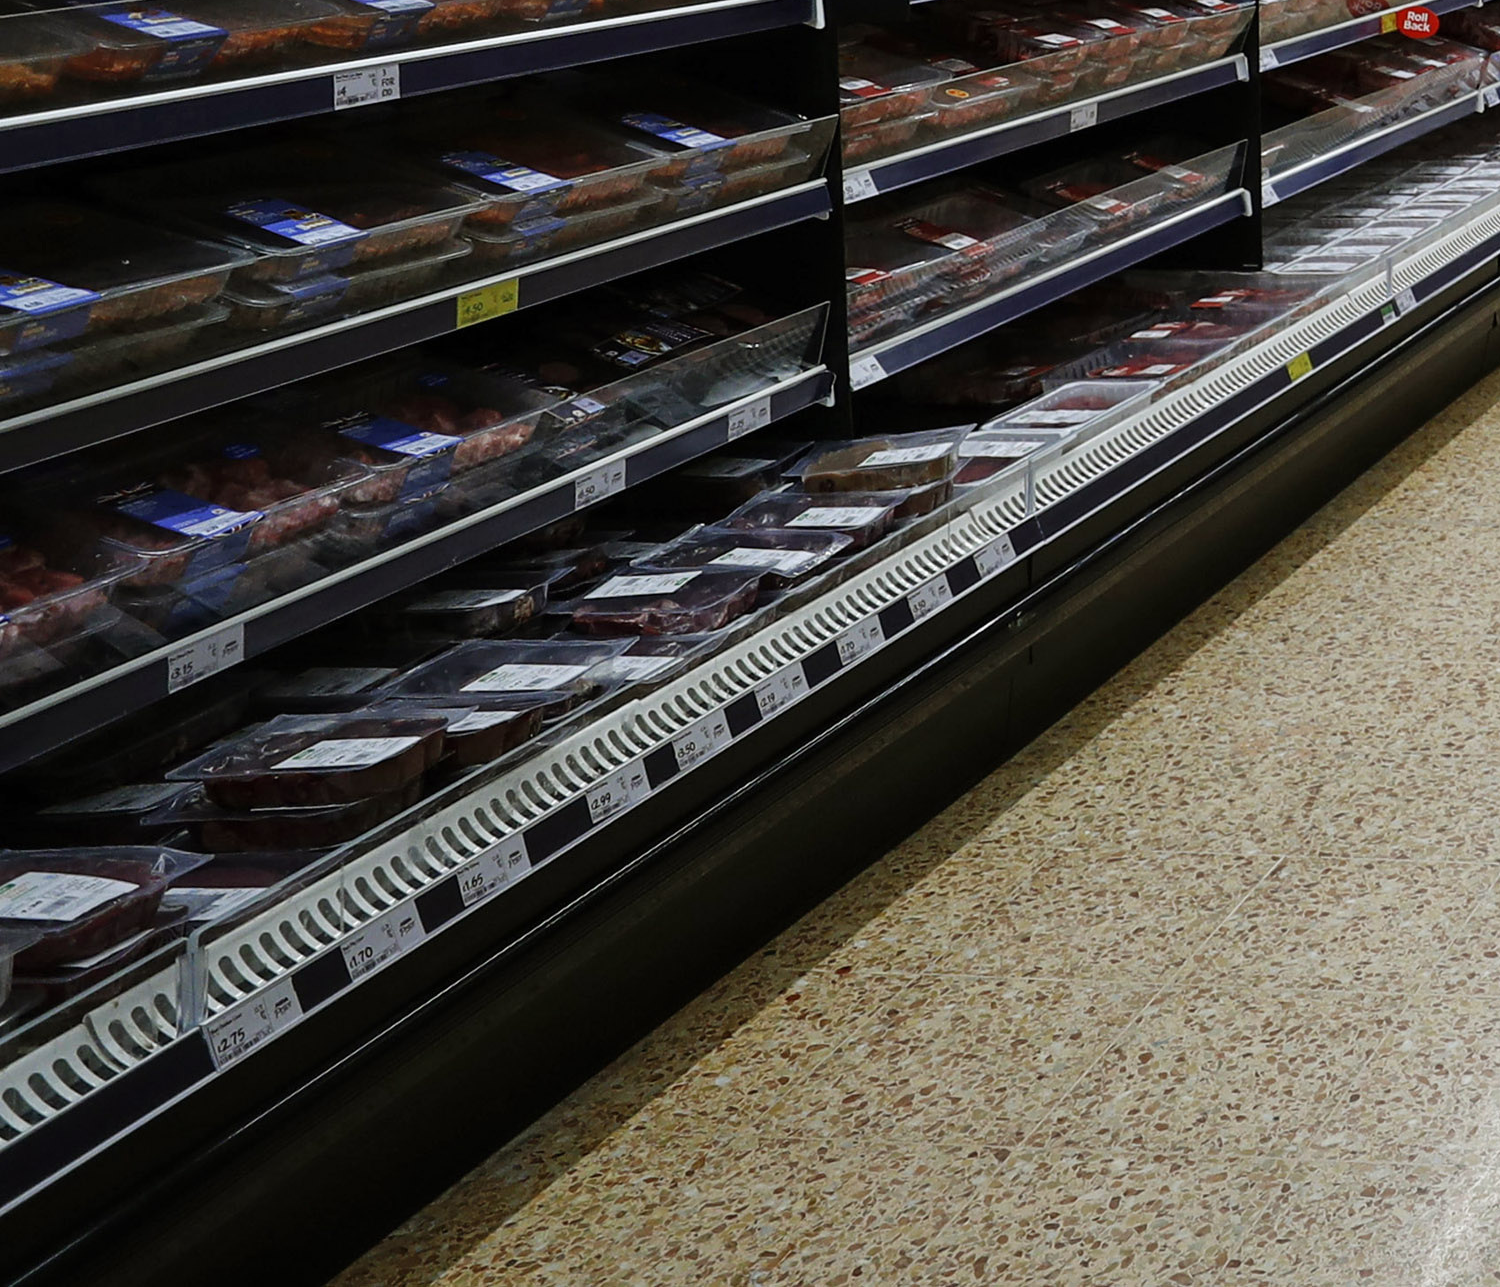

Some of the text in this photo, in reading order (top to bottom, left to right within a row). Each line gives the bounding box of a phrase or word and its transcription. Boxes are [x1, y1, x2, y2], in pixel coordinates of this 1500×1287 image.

[1407, 11, 1429, 22] Roll
[1403, 20, 1431, 33] Back
[349, 947, 373, 969] £1.70
[218, 1028, 246, 1054] £2.75
